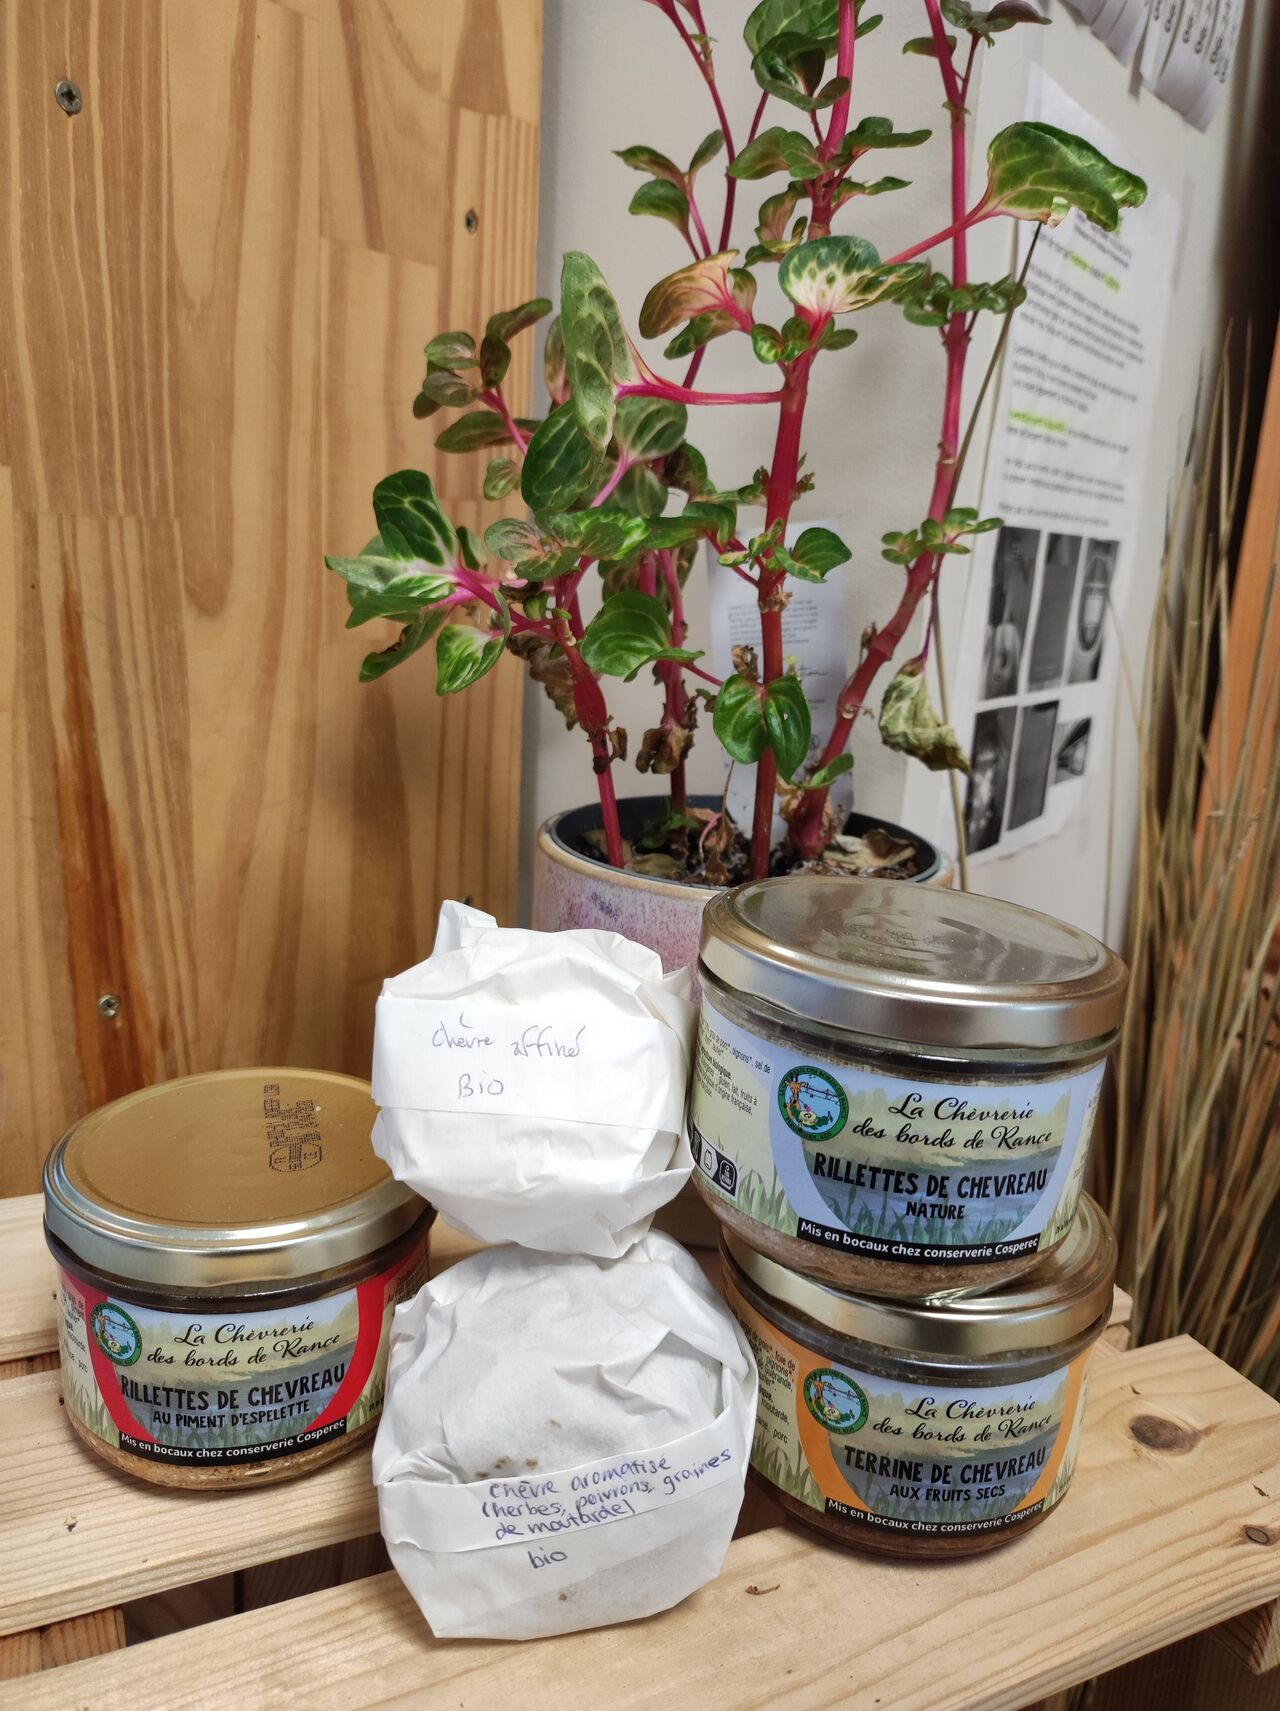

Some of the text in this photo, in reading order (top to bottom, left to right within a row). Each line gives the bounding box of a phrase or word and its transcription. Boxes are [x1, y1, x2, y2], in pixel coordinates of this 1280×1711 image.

[888, 1092, 1034, 1122] La Chèvrerie
[852, 1117, 887, 1138] des
[895, 1123, 956, 1149] bords
[963, 1130, 984, 1150] de
[990, 1125, 1053, 1150] Rance
[813, 1152, 1049, 1199] RILLETTES DE CHEVREAU
[905, 1201, 966, 1220] NATURE
[800, 1221, 1039, 1259] Mis en bocaux chez conserverie Cosperec
[174, 1316, 315, 1347] La Chèvrerie
[147, 1334, 341, 1368] des bords de Rance
[787, 1358, 796, 1372] de
[121, 1374, 210, 1411] RILLETTES
[217, 1389, 240, 1410] DE
[247, 1362, 346, 1407] CHEVREAU
[152, 1399, 311, 1428] AU PIMENT D'ESPELETTE
[904, 1395, 1036, 1420] La Chèvrerie
[121, 1419, 346, 1459] Mis en bocaux chez conserverie Cosperec
[773, 1428, 789, 1444] porc
[872, 1415, 1052, 1443] des bords de Rance
[663, 1448, 732, 1496] graines
[844, 1444, 1047, 1484] TERRINE DE CHEVREAU
[889, 1484, 1006, 1502] AUX FRUITS SECS
[828, 1499, 1044, 1532] Mis en bocaux chez conserverie Cosperec
[496, 1522, 525, 1540] de
[527, 1547, 568, 1569] bio
